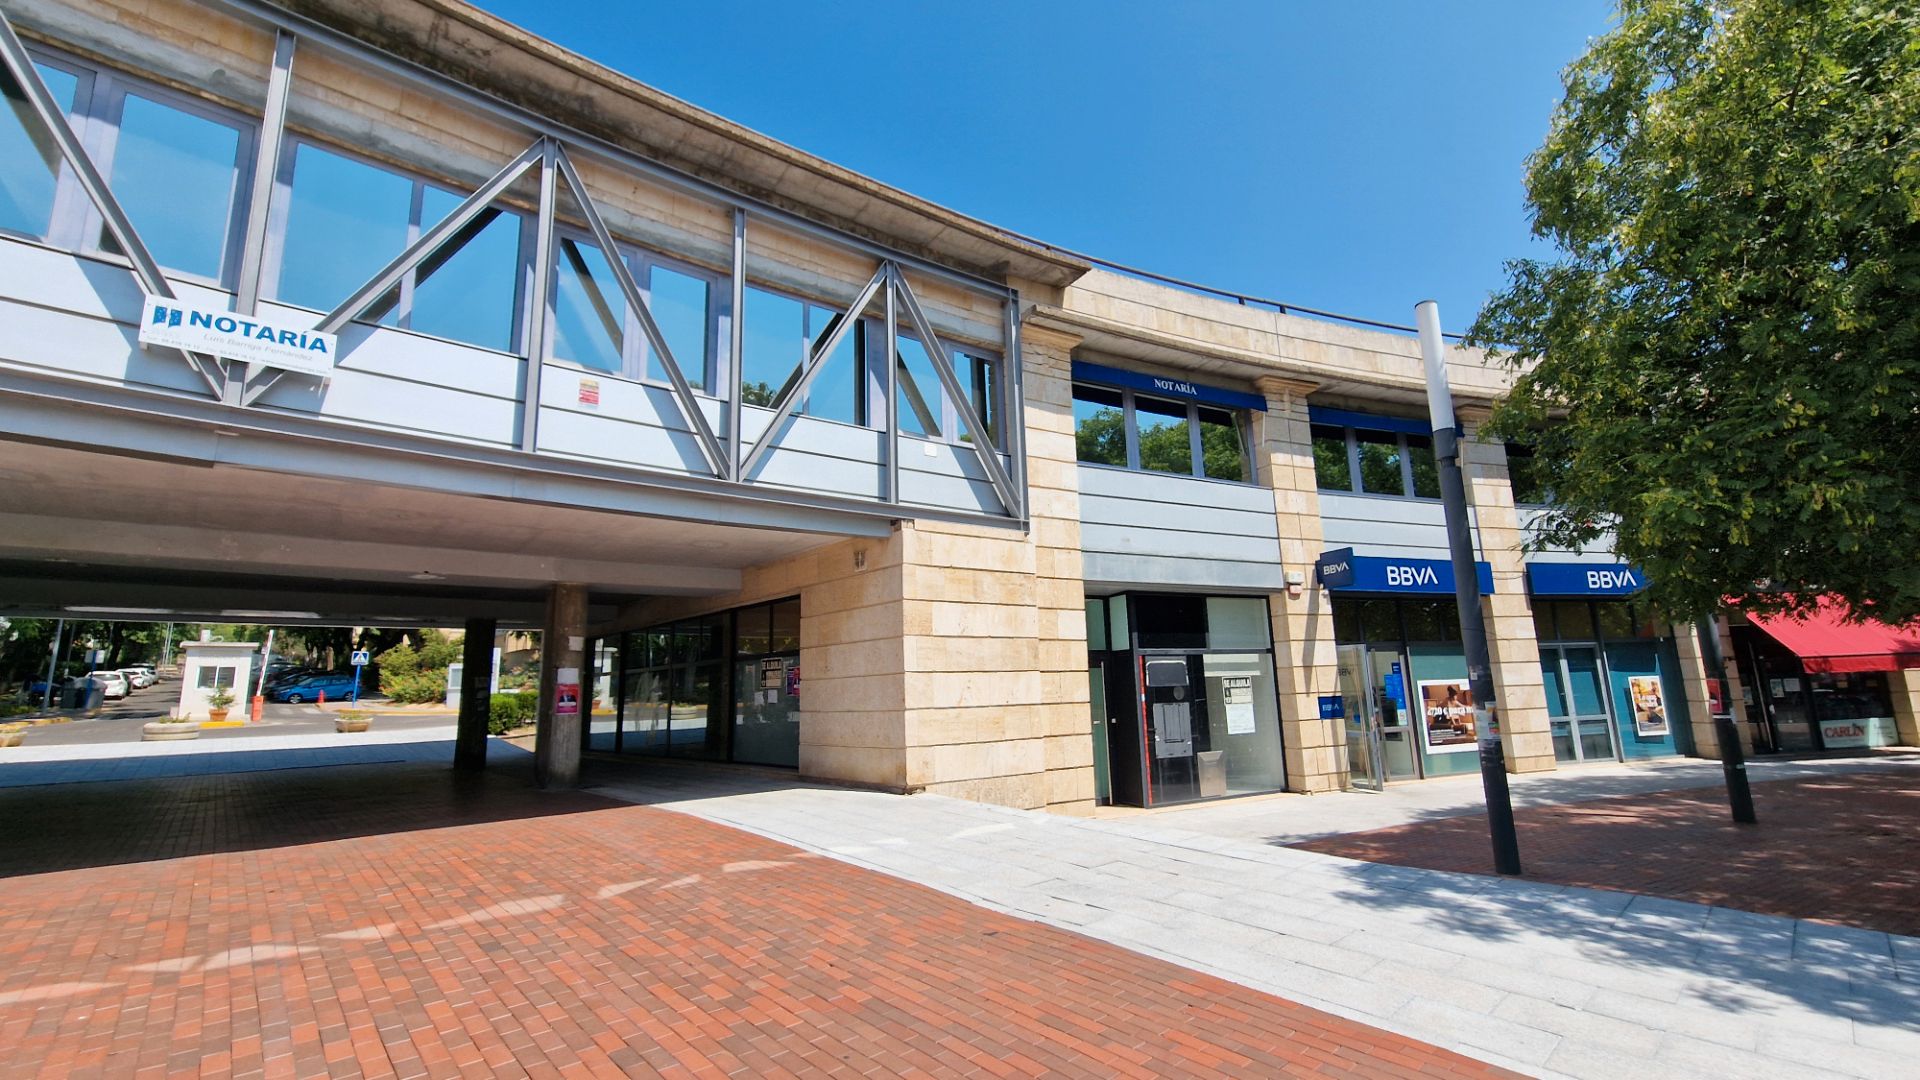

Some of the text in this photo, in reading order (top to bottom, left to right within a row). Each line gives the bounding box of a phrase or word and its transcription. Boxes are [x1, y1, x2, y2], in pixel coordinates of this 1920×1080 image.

[190, 310, 328, 353] NOTARÍA
[1153, 378, 1198, 396] NOTARÍA
[1323, 561, 1350, 575] BBVA
[1386, 566, 1439, 586] BBVA
[1586, 569, 1637, 589] BBVA
[1824, 726, 1865, 738] CARLIN
